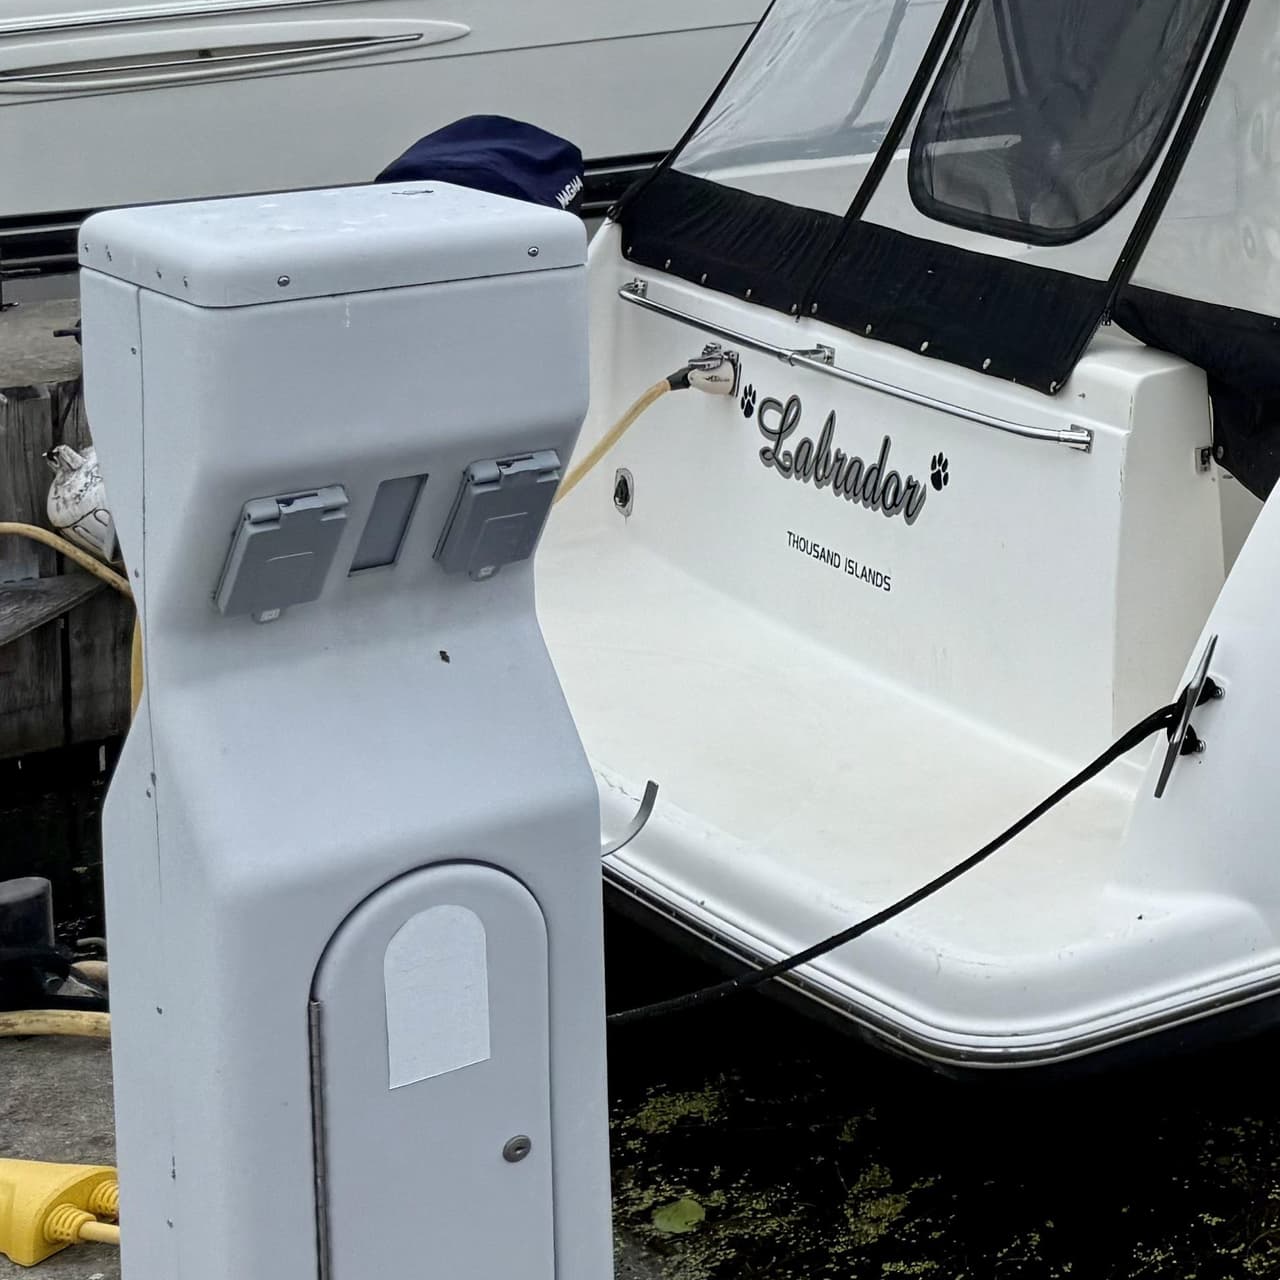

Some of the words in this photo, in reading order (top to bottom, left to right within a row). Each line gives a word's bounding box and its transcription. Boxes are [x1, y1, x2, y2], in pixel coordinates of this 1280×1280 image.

[554, 175, 584, 209] MAGMA
[757, 394, 927, 526] Labrador
[787, 530, 841, 568] THOUSAND
[844, 557, 892, 592] ISLANDS
